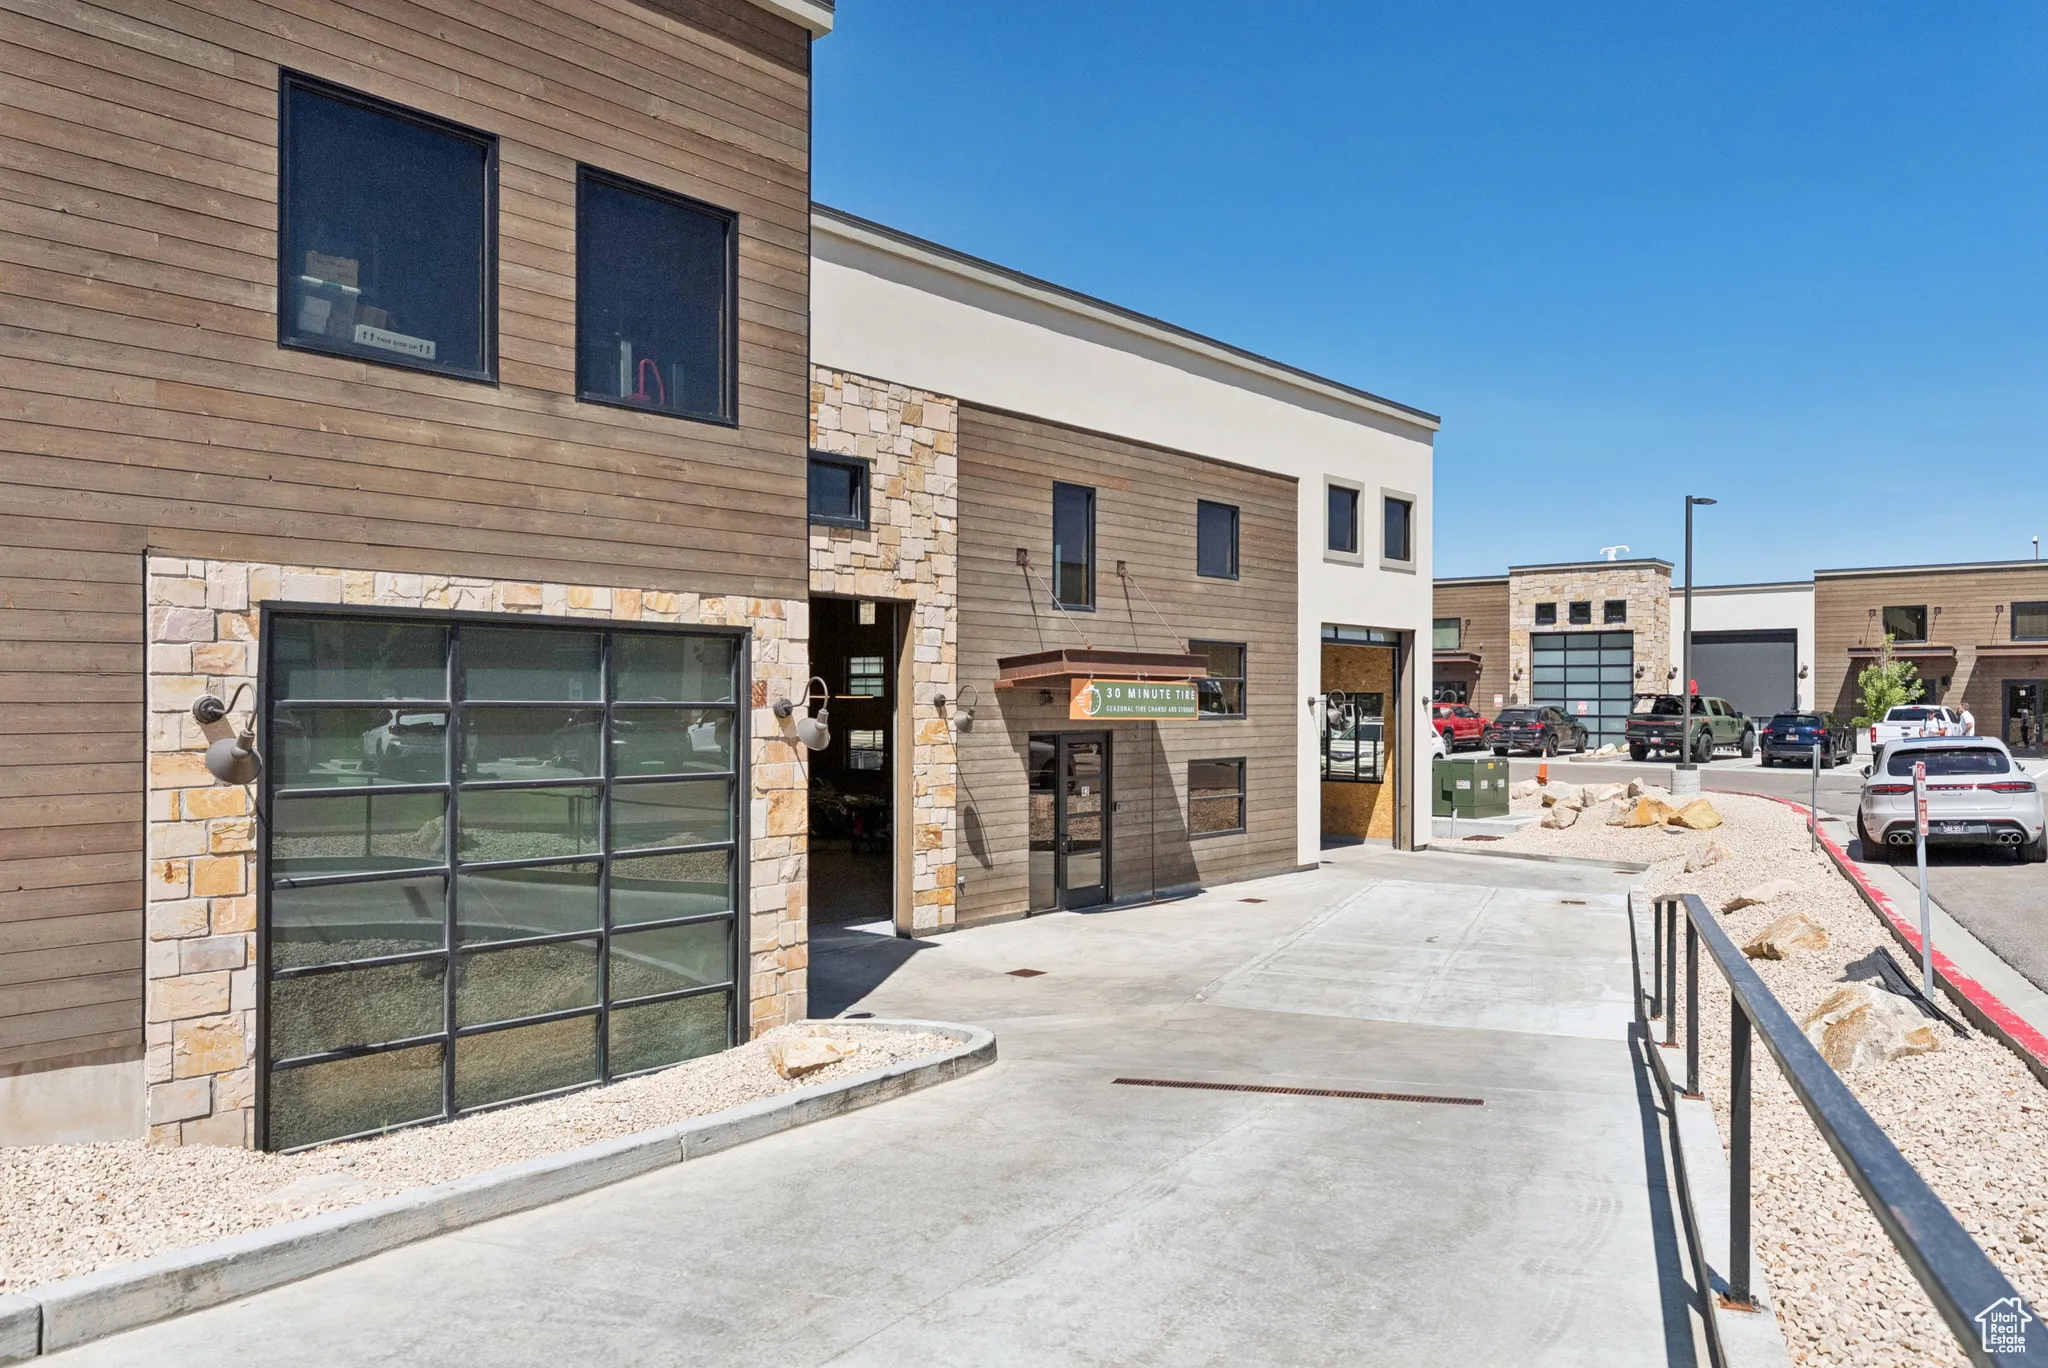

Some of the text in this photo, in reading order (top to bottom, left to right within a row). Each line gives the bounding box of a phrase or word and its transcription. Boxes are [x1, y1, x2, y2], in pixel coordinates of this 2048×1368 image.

[376, 336, 391, 344] THIS
[393, 340, 407, 348] SIDE
[1106, 687, 1196, 700] 30 MINUTE TIRE
